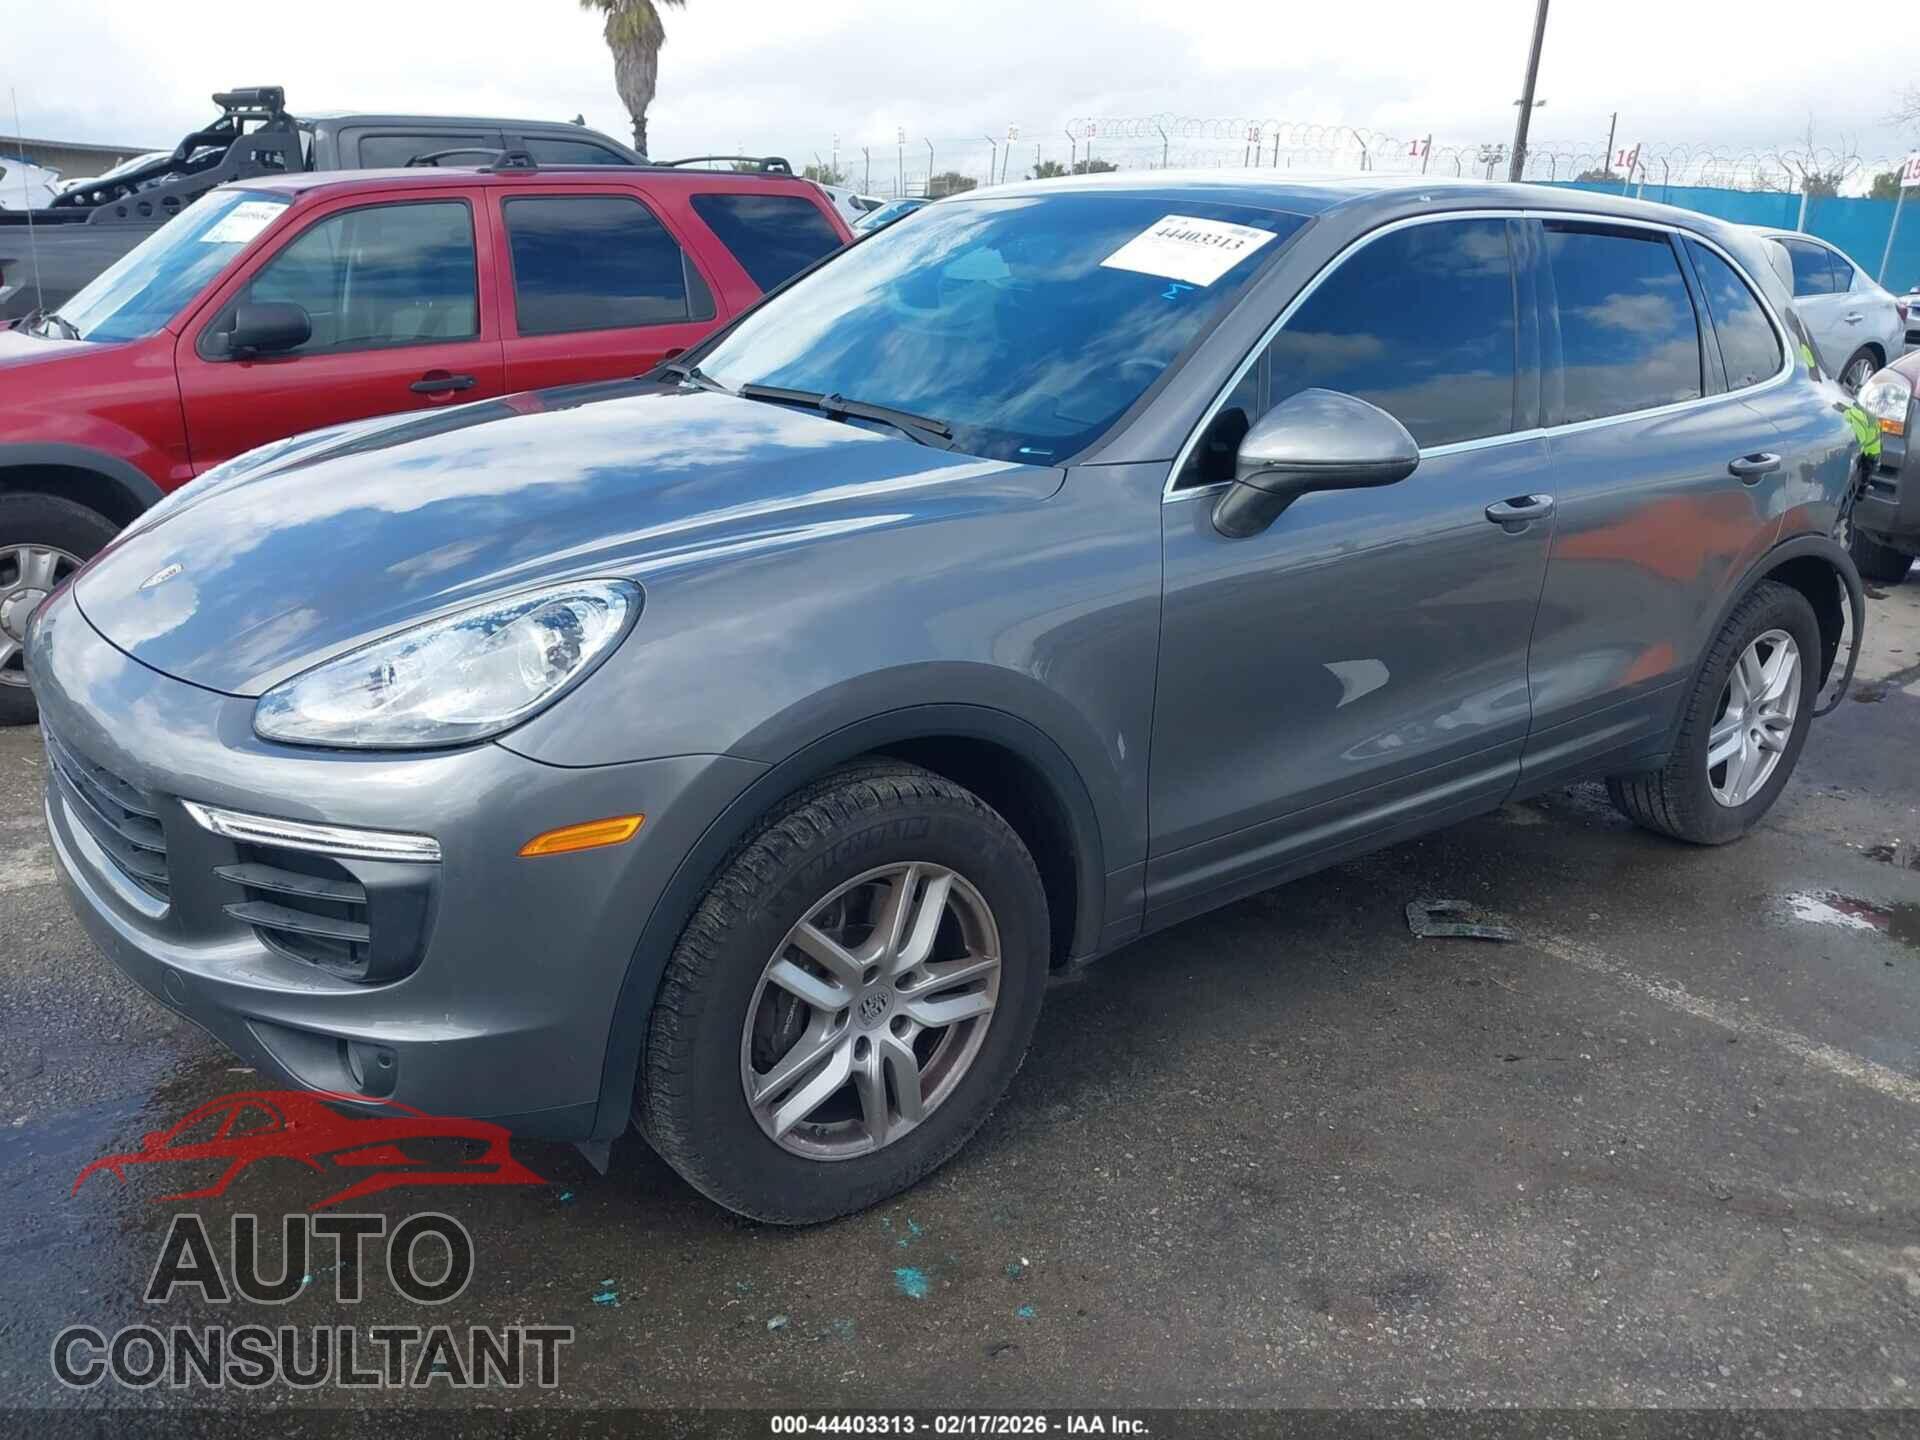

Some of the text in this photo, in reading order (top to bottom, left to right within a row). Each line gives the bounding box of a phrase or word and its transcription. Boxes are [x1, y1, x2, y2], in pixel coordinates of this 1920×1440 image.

[1247, 127, 1259, 142] 18
[1408, 139, 1431, 157] 17
[1155, 226, 1245, 250] 44403313
